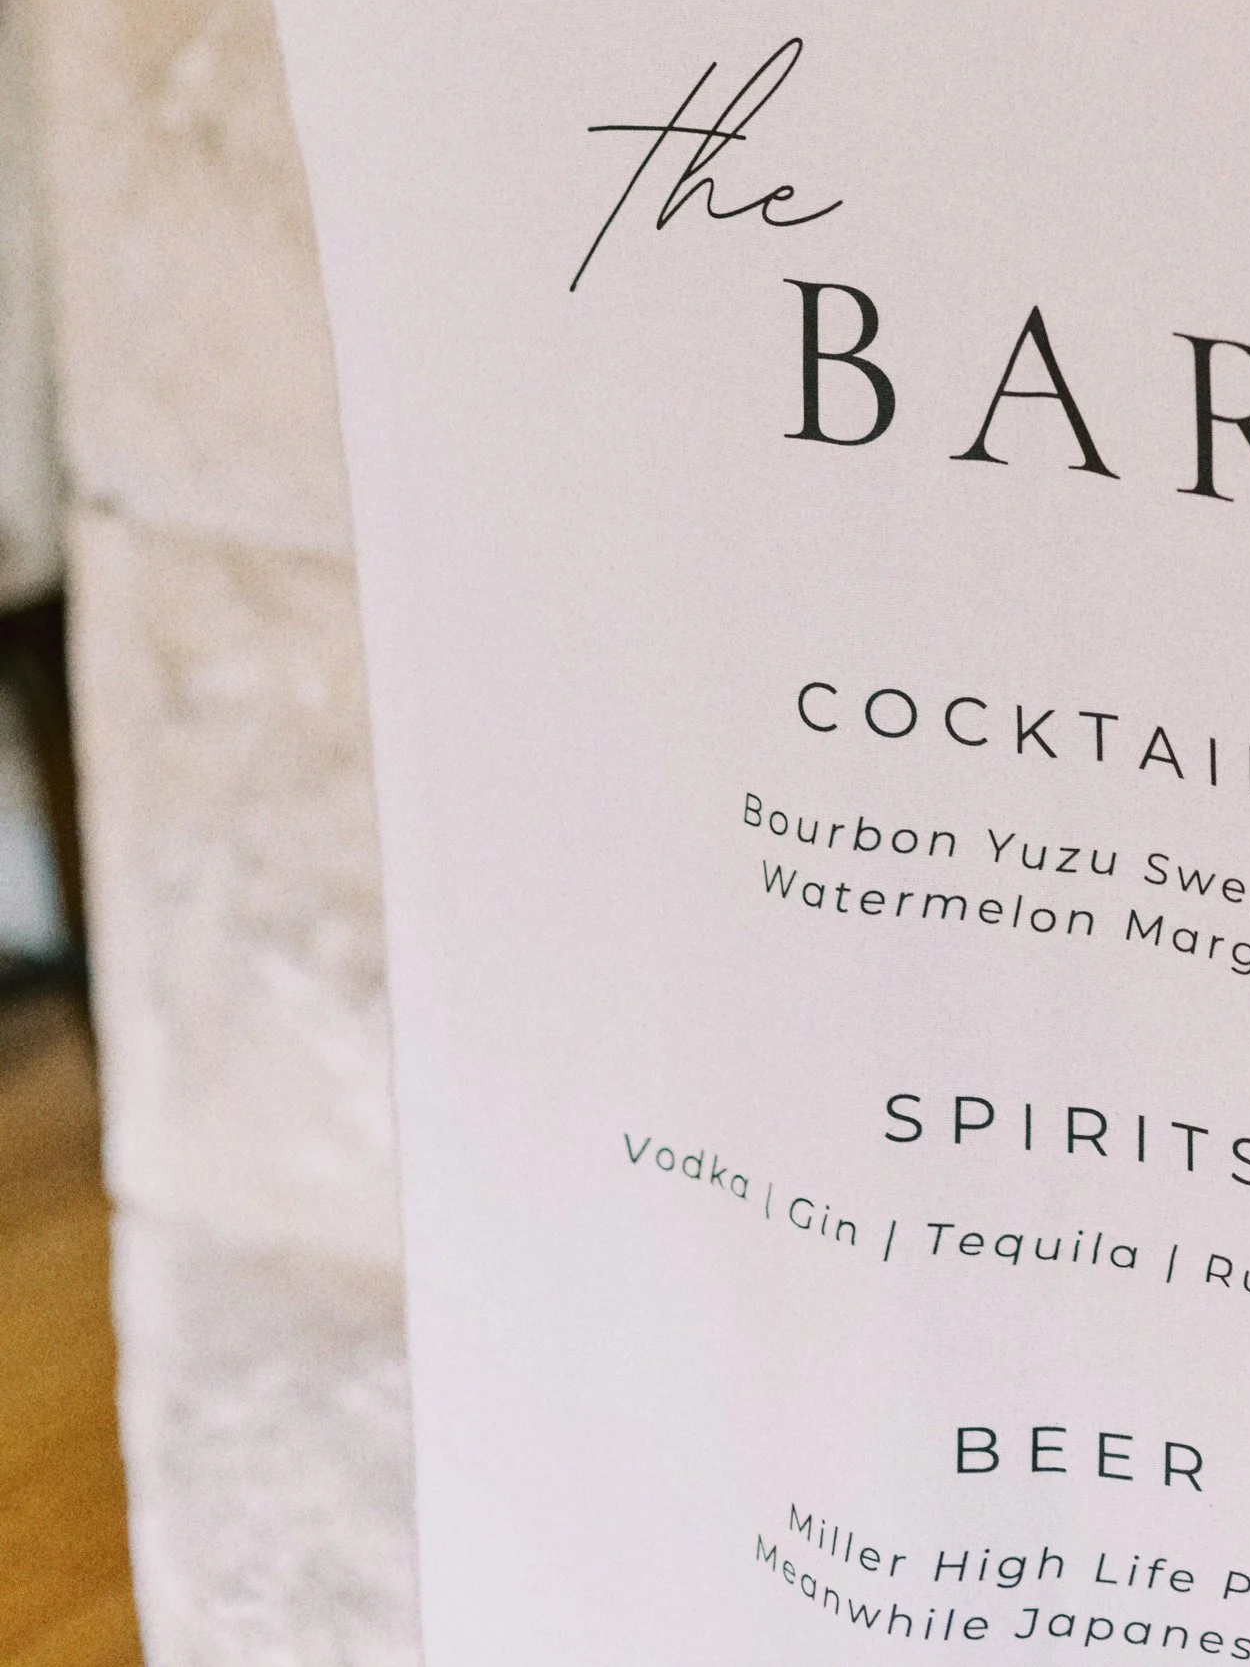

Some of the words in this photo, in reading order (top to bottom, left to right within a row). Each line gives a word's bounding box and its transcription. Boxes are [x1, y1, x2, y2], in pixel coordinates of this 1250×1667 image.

[569, 36, 844, 294] the
[742, 791, 957, 859] Bourbon
[987, 828, 1118, 878] Yuzu
[762, 859, 1095, 938] Watermelon
[623, 1132, 749, 1202] Vodka
[788, 1196, 857, 1247] Gin
[926, 1221, 1140, 1271] Tequila
[955, 1425, 1204, 1494] BEER
[755, 1533, 990, 1643] Meanwhile
[789, 1502, 908, 1579] Miller
[933, 1545, 1066, 1591] High
[1094, 1552, 1196, 1596] Life
